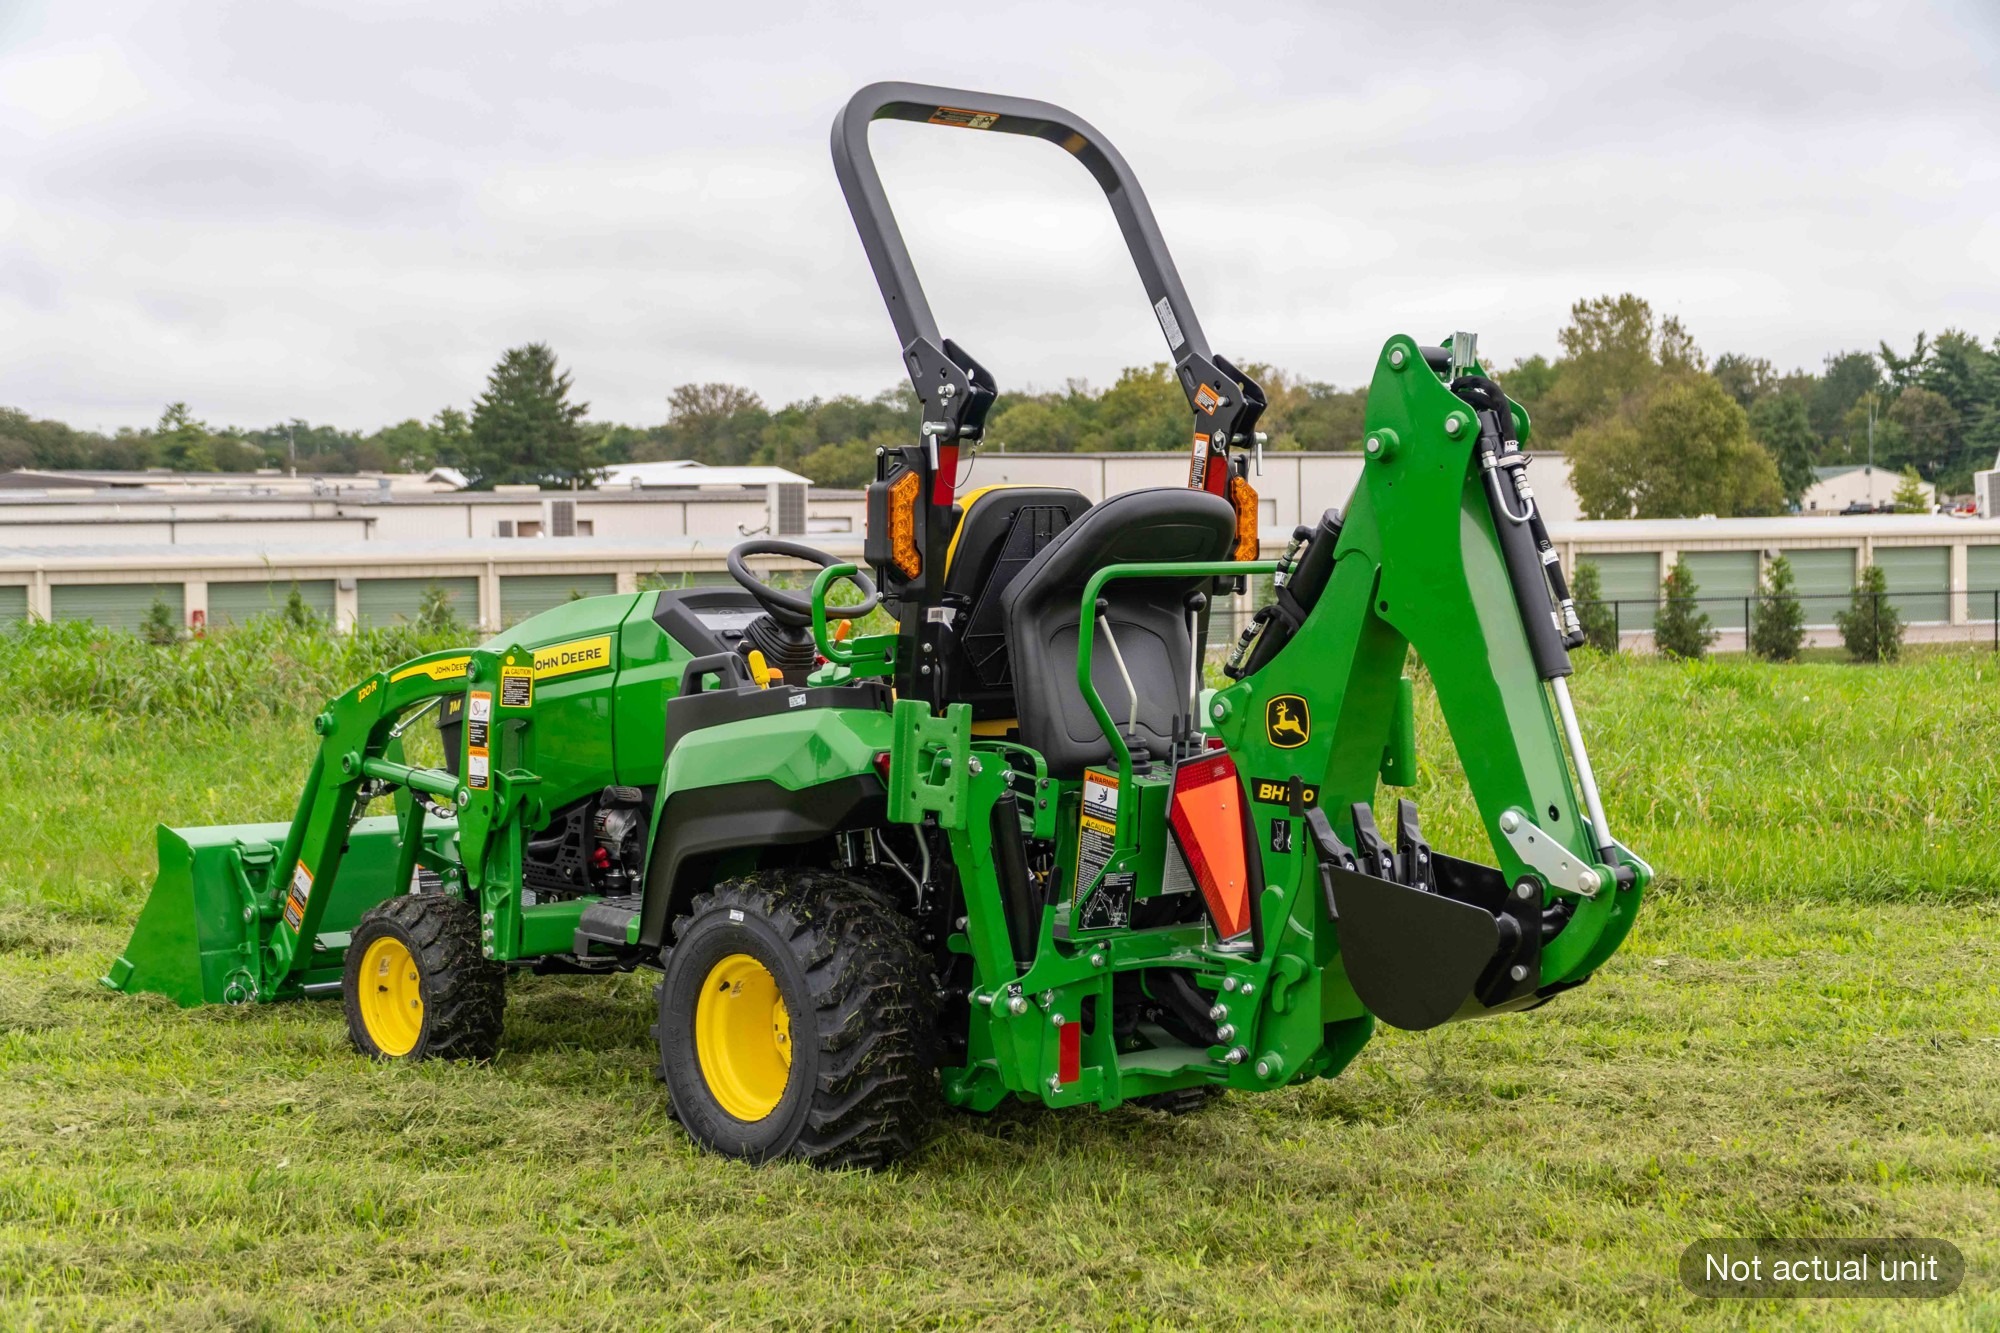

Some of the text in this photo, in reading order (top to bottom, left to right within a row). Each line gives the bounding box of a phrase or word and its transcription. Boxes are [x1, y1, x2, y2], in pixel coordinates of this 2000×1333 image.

[535, 648, 602, 670] OHN DEERE
[435, 662, 467, 674] JOHN DEER
[511, 668, 531, 676] CAUTION
[449, 700, 461, 714] 1M
[1094, 775, 1119, 788] WARNING
[1090, 822, 1115, 834] CAUTION
